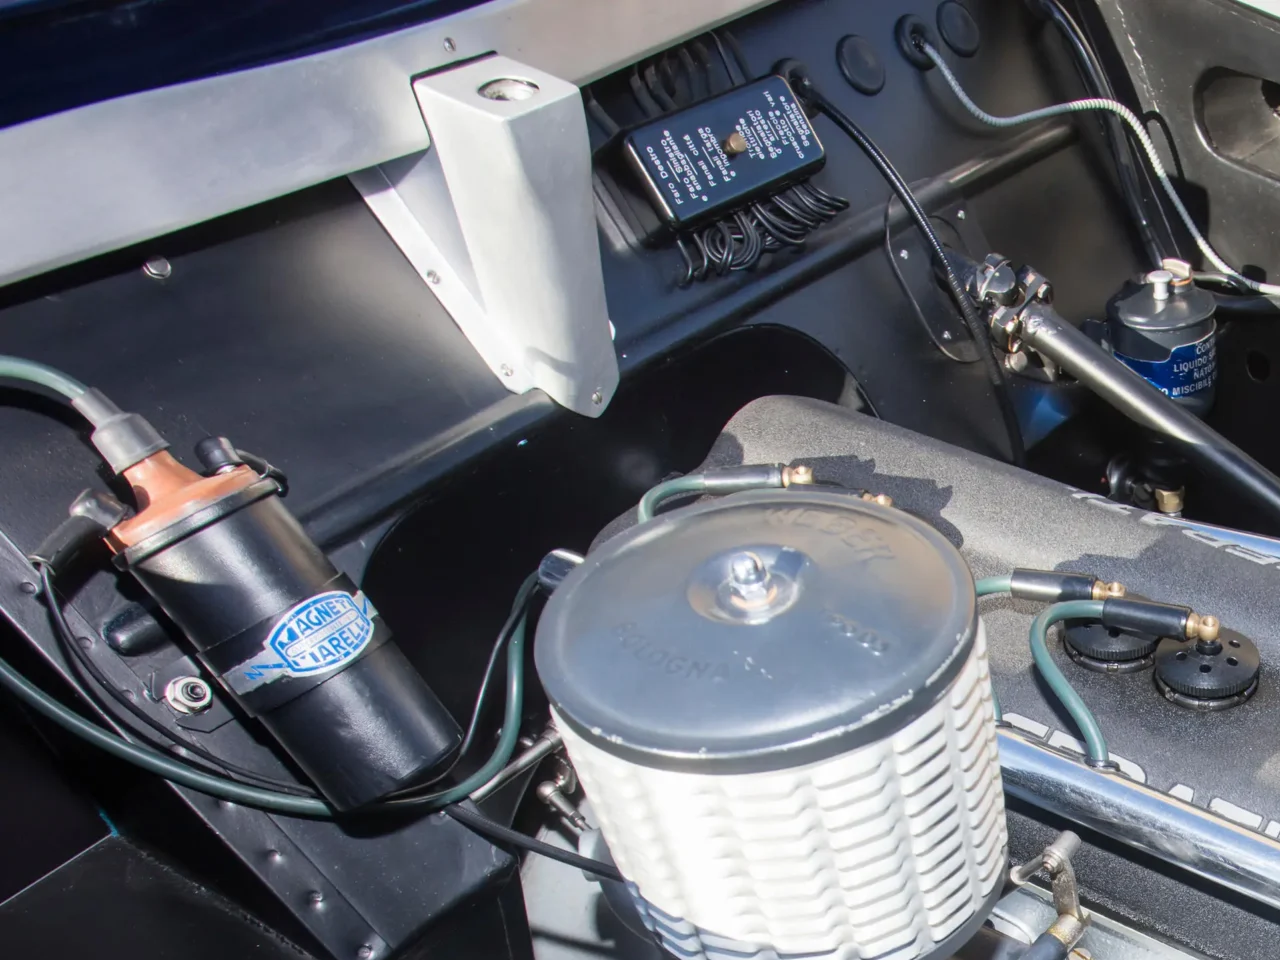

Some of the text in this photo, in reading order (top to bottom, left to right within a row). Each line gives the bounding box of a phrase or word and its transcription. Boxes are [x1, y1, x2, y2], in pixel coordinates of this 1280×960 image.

[763, 91, 775, 107] vari
[754, 110, 775, 144] arresto
[788, 102, 811, 135] benzina
[697, 128, 731, 182] Fanali targa
[705, 127, 730, 167] ingombro
[739, 118, 765, 160] elettriche
[780, 119, 805, 159] cruscotto
[646, 146, 684, 205] Faro Destro
[660, 139, 699, 199] Faro Sinistro
[697, 160, 717, 187] Fanali
[1173, 355, 1208, 373] LIQUIDO
[1172, 376, 1212, 396] MISCIBILE
